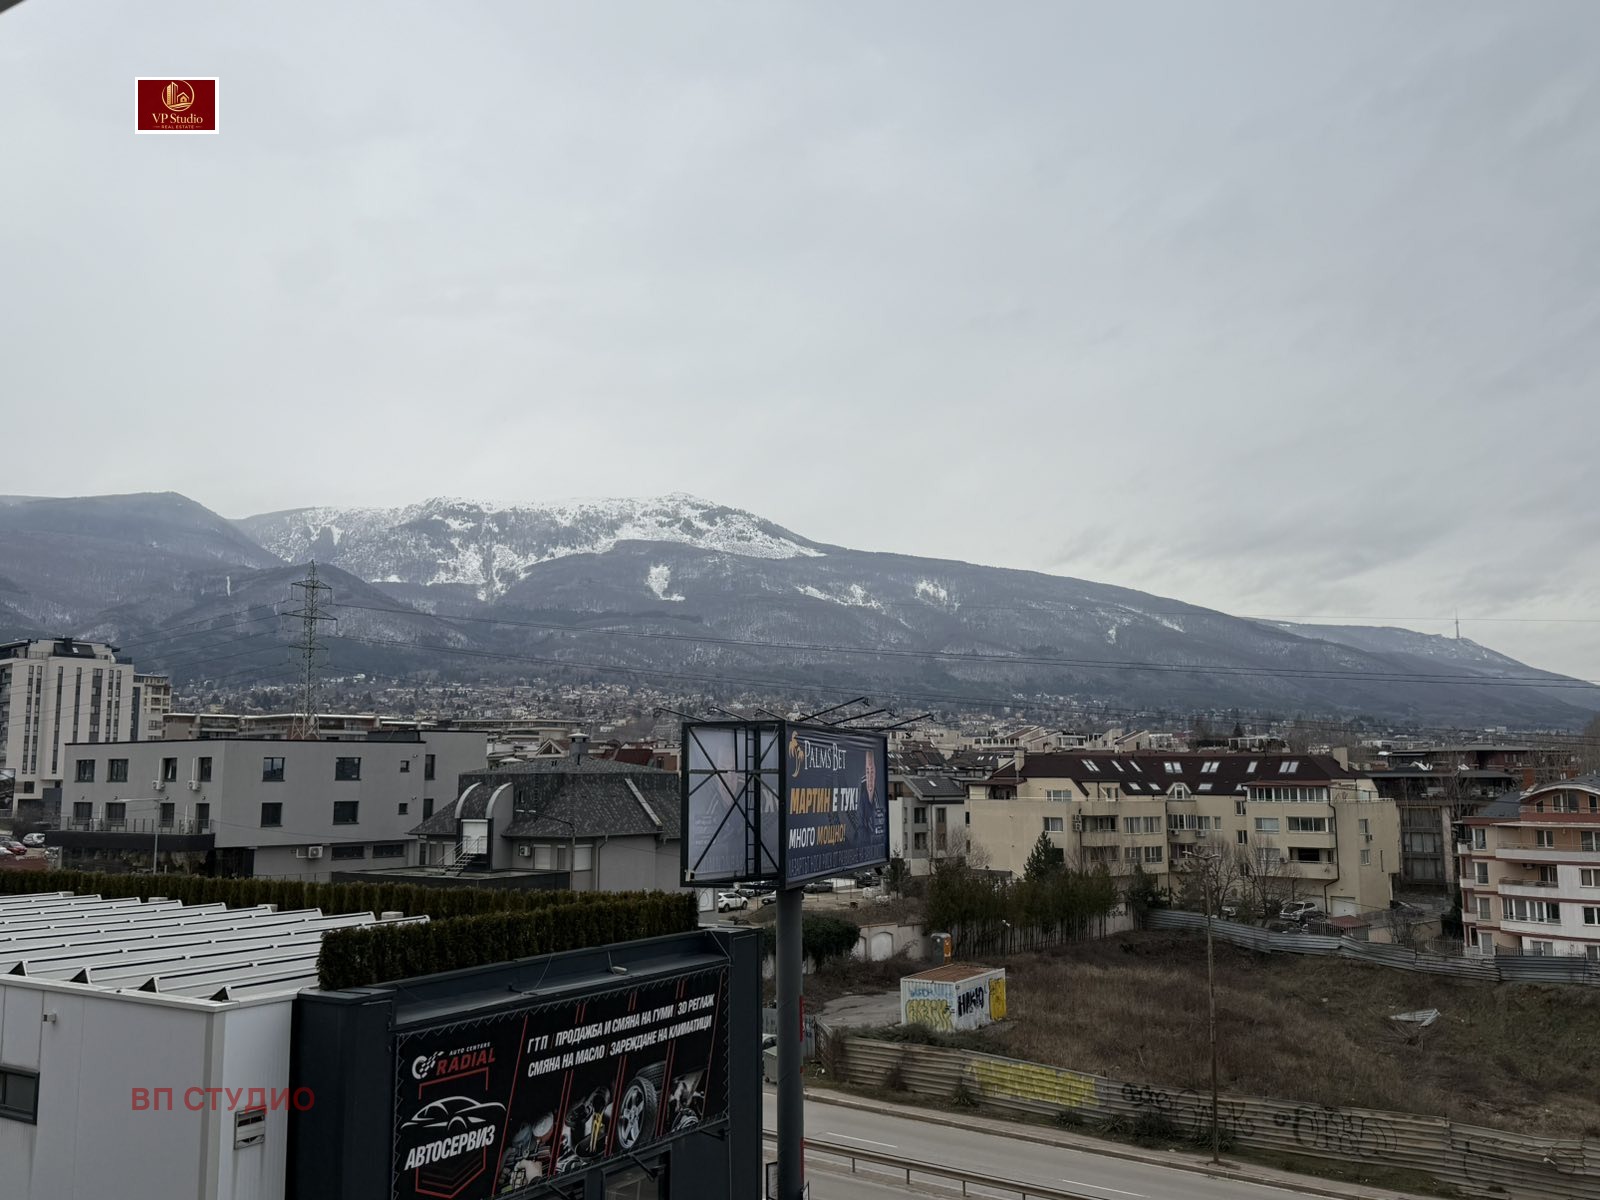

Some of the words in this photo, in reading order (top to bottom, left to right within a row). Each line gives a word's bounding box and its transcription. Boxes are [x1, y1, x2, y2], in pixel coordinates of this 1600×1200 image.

[790, 788, 831, 814] МАРТИН
[832, 788, 838, 811] Е
[840, 788, 859, 811] ТУК!
[789, 826, 815, 849] МНОГО
[816, 824, 846, 846] МОЩНО!
[527, 1035, 549, 1054] ГТП
[555, 1022, 603, 1048] ПРОДАЖБА
[603, 1020, 612, 1035] И
[611, 1014, 640, 1034] СМЯНА
[641, 1011, 652, 1026] НА
[651, 1004, 674, 1023] ГУМИ
[677, 1001, 689, 1016] 3D
[688, 994, 715, 1013] РЕГЛАЖ
[449, 1046, 465, 1056] AUTO
[466, 1041, 491, 1052] CENTERS
[527, 1055, 561, 1078] СМЯНА
[562, 1051, 575, 1067] НА
[575, 1044, 605, 1066] МАСЛО
[609, 1032, 656, 1056] ЗАРЕЖДАНЕ
[657, 1028, 668, 1042] НА
[668, 1015, 712, 1039] КЛИМАТИЦИ
[436, 1047, 496, 1076] RADIAL
[404, 1124, 496, 1171] АВТОСЕРВИЗ
